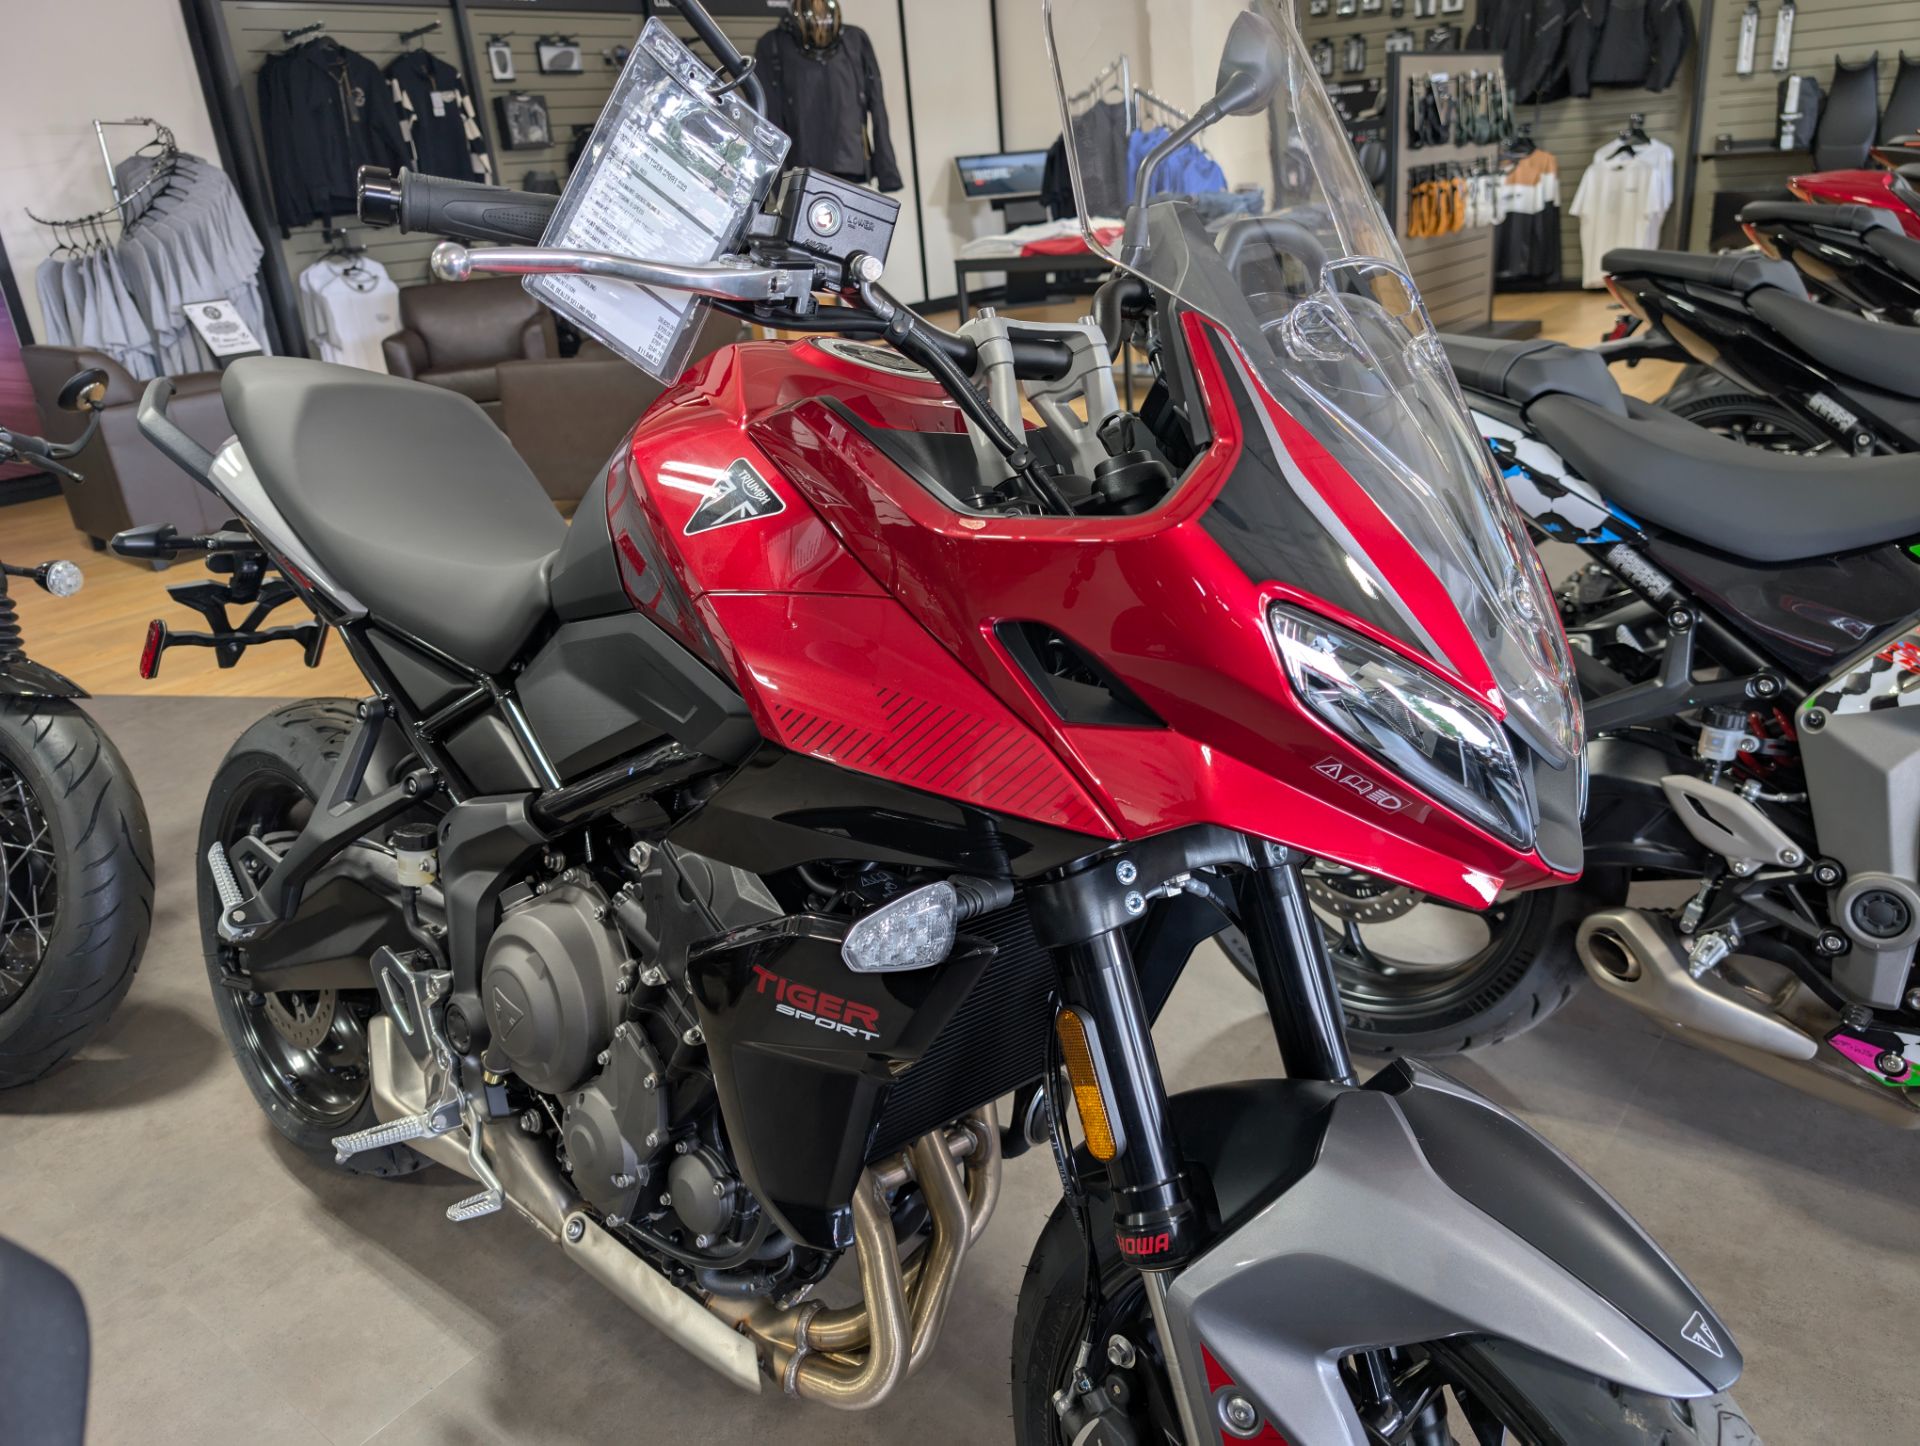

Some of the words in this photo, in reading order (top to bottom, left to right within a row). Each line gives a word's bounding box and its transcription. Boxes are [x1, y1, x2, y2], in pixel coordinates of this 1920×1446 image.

[738, 467, 772, 506] TRIUMPH
[752, 964, 881, 1032] TIGER
[775, 1003, 880, 1041] SPORT
[1116, 1232, 1169, 1255] HOWA
